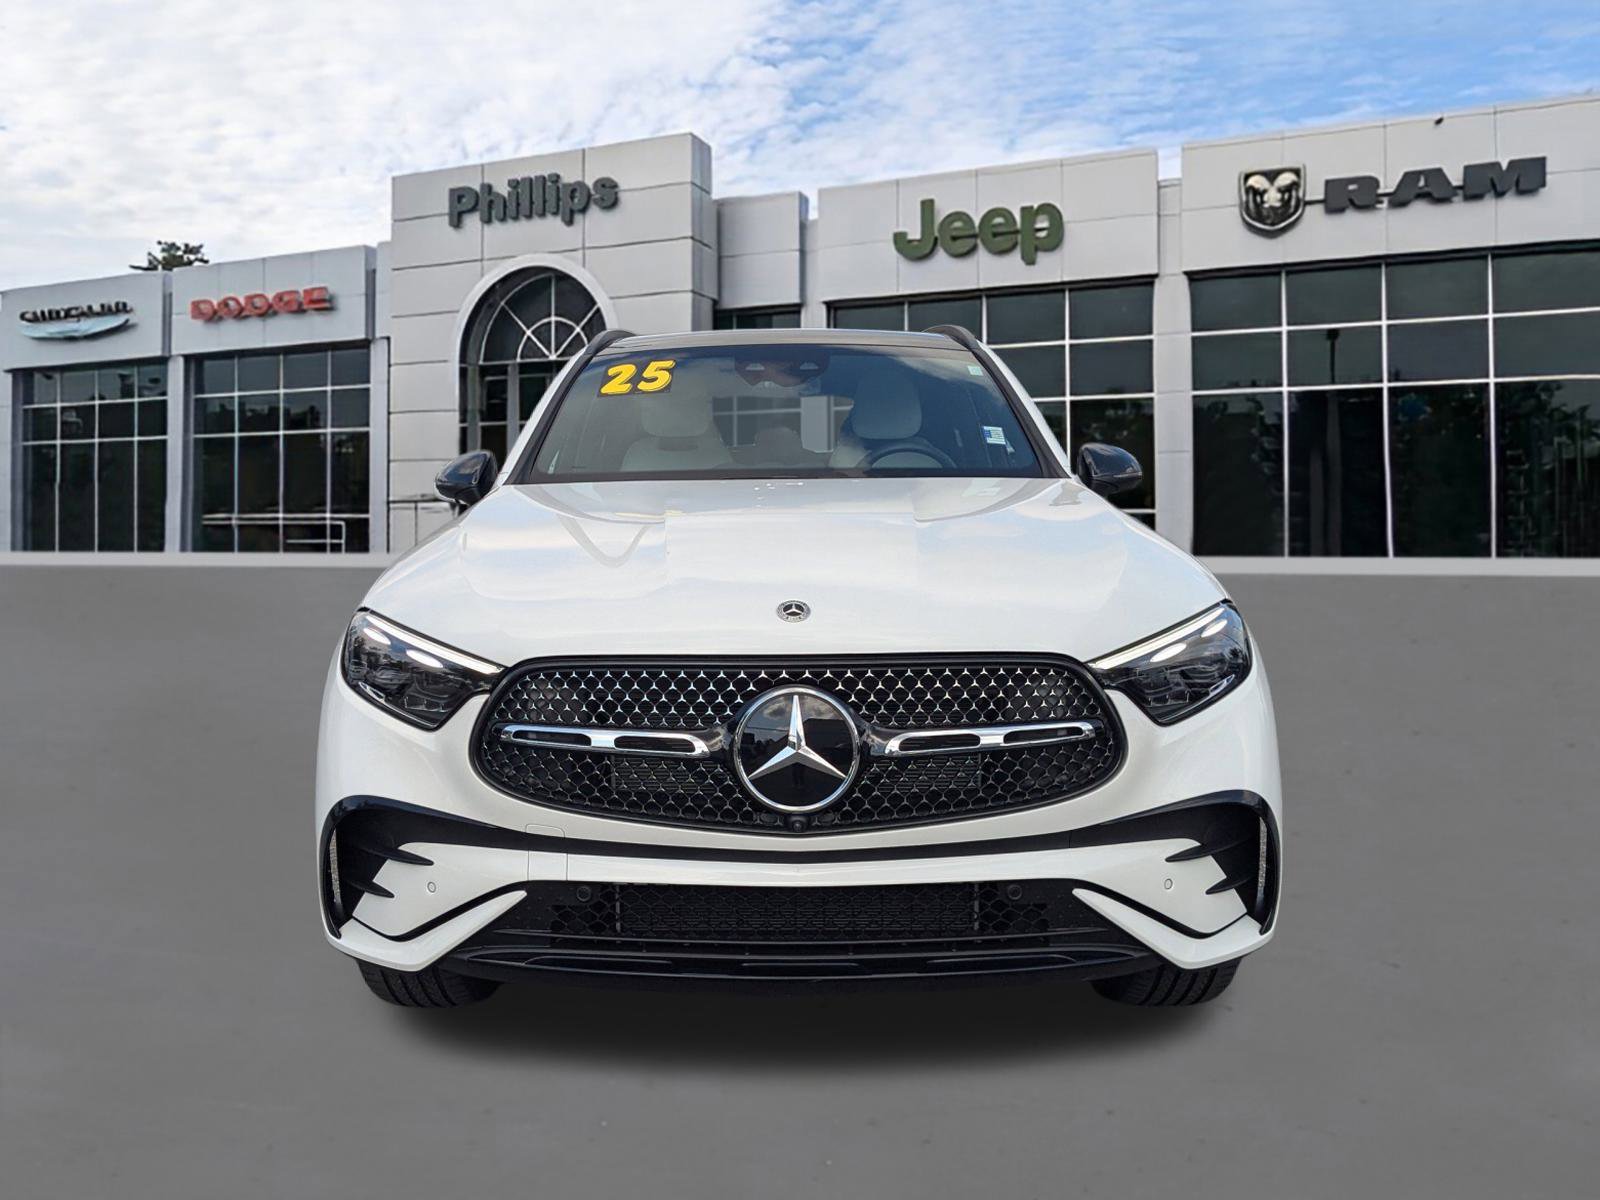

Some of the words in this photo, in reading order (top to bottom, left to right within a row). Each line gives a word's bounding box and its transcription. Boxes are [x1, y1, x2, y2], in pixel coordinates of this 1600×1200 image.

[449, 173, 618, 228] Phillips
[1324, 156, 1547, 213] RAM
[893, 198, 1064, 266] Jeep
[190, 286, 333, 322] DODGE
[600, 360, 675, 394] 25
